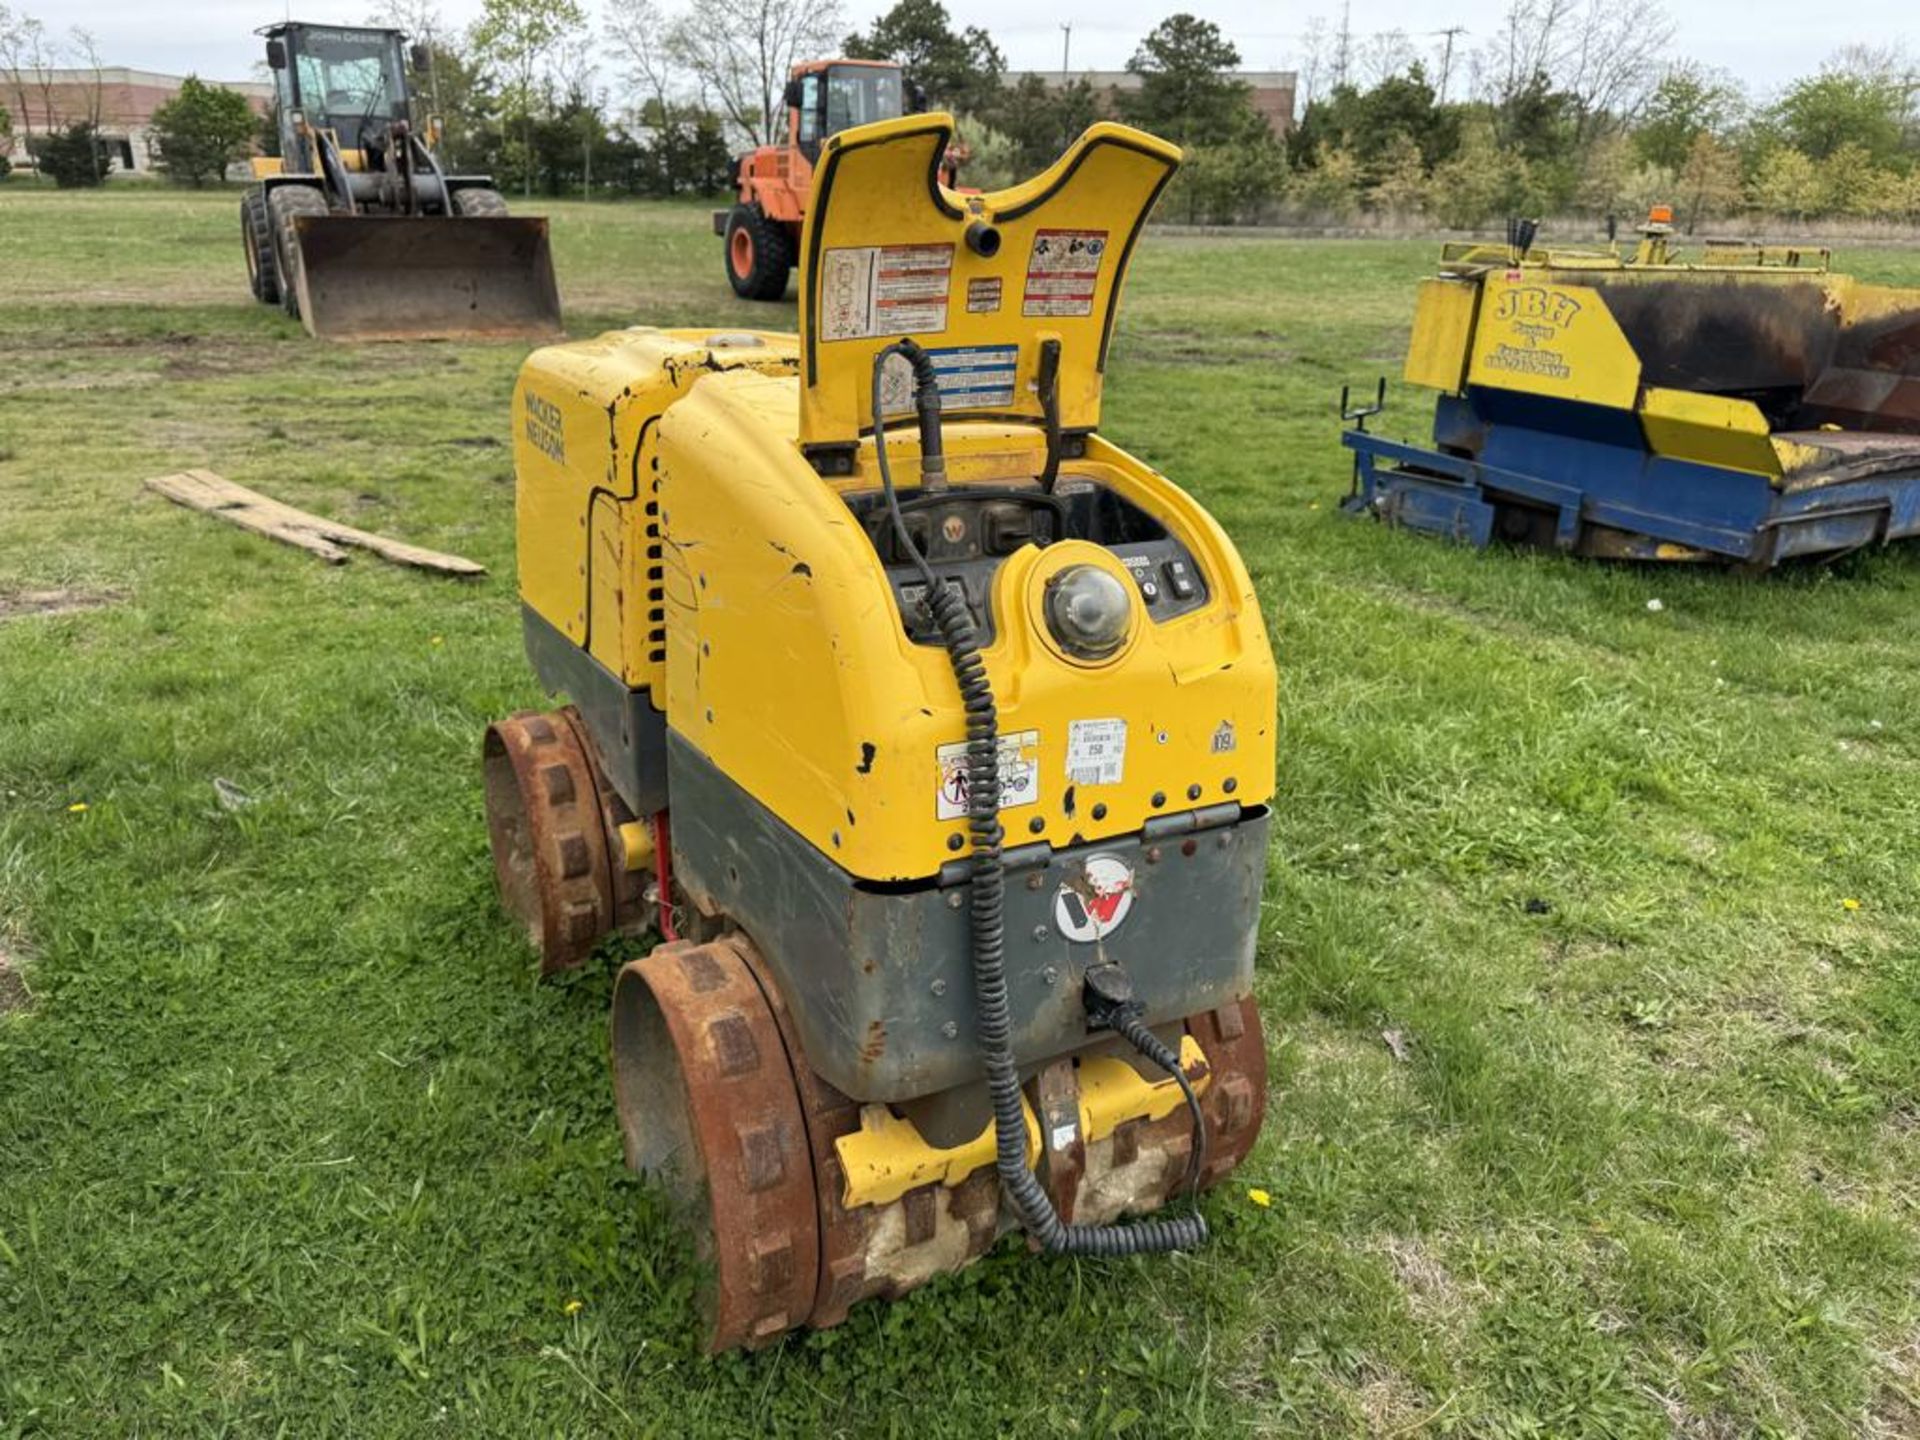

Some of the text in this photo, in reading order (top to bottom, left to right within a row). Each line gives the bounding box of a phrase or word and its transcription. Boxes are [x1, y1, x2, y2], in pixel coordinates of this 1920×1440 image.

[1495, 287, 1582, 328] JBH
[524, 390, 562, 432] WACKER
[526, 418, 565, 466] NEUSON
